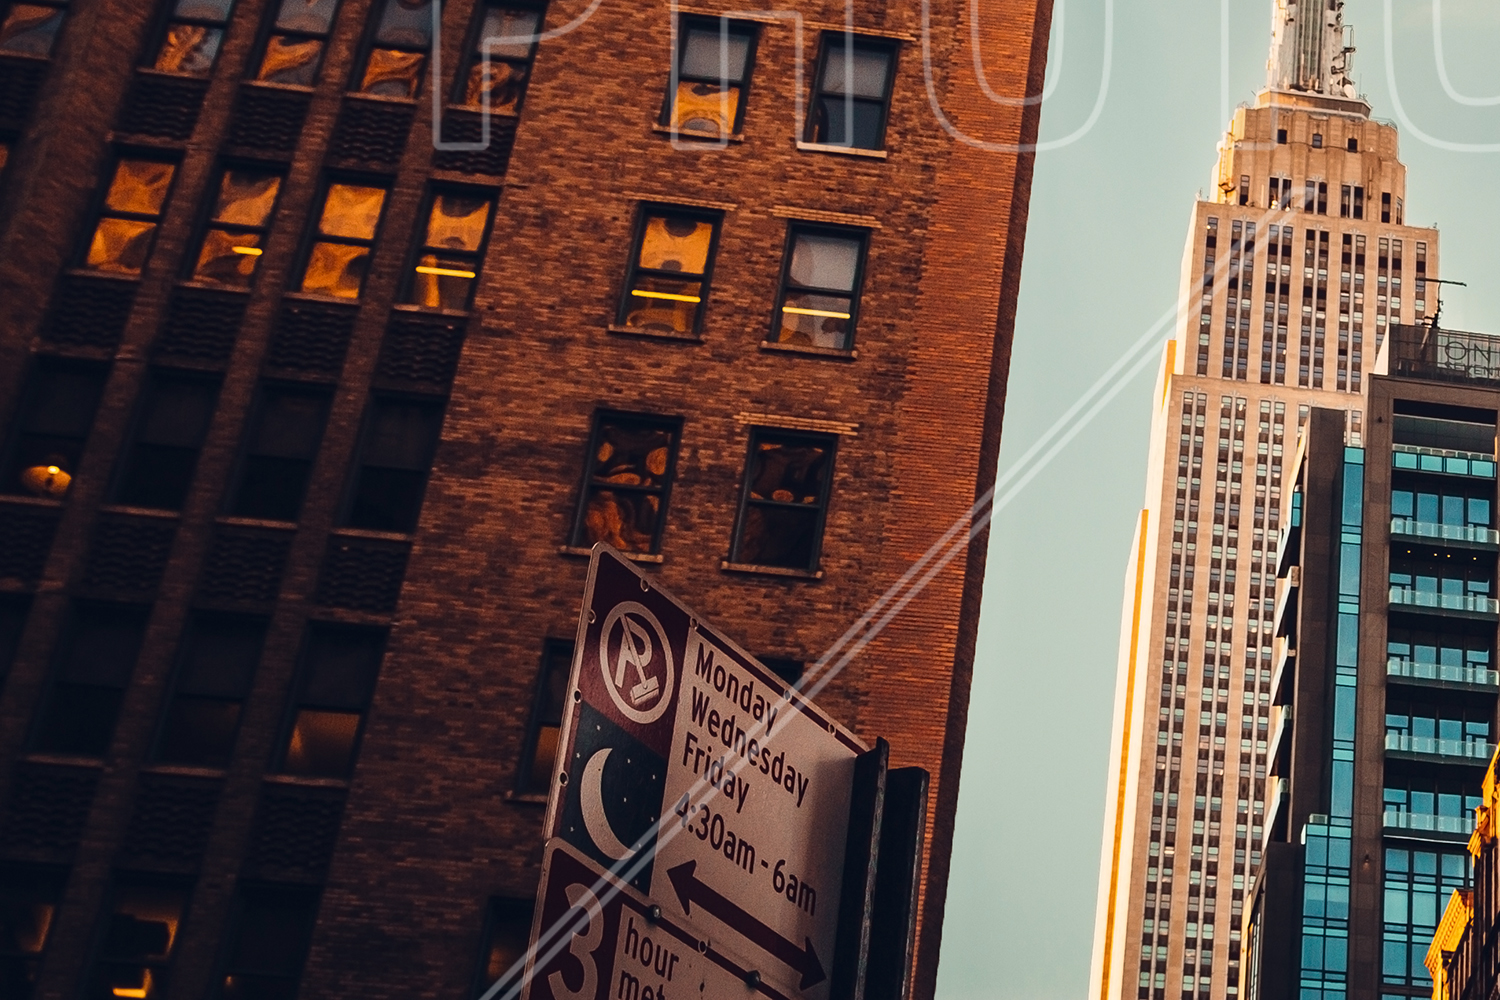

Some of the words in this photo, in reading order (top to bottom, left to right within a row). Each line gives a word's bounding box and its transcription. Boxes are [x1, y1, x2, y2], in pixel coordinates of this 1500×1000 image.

[695, 642, 779, 737] Monday
[682, 731, 750, 814] Friday
[691, 686, 809, 808] Wednesday
[674, 792, 756, 874] 4:30am
[772, 859, 817, 917] 6am
[548, 882, 605, 1000] 3
[624, 916, 680, 982] hour
